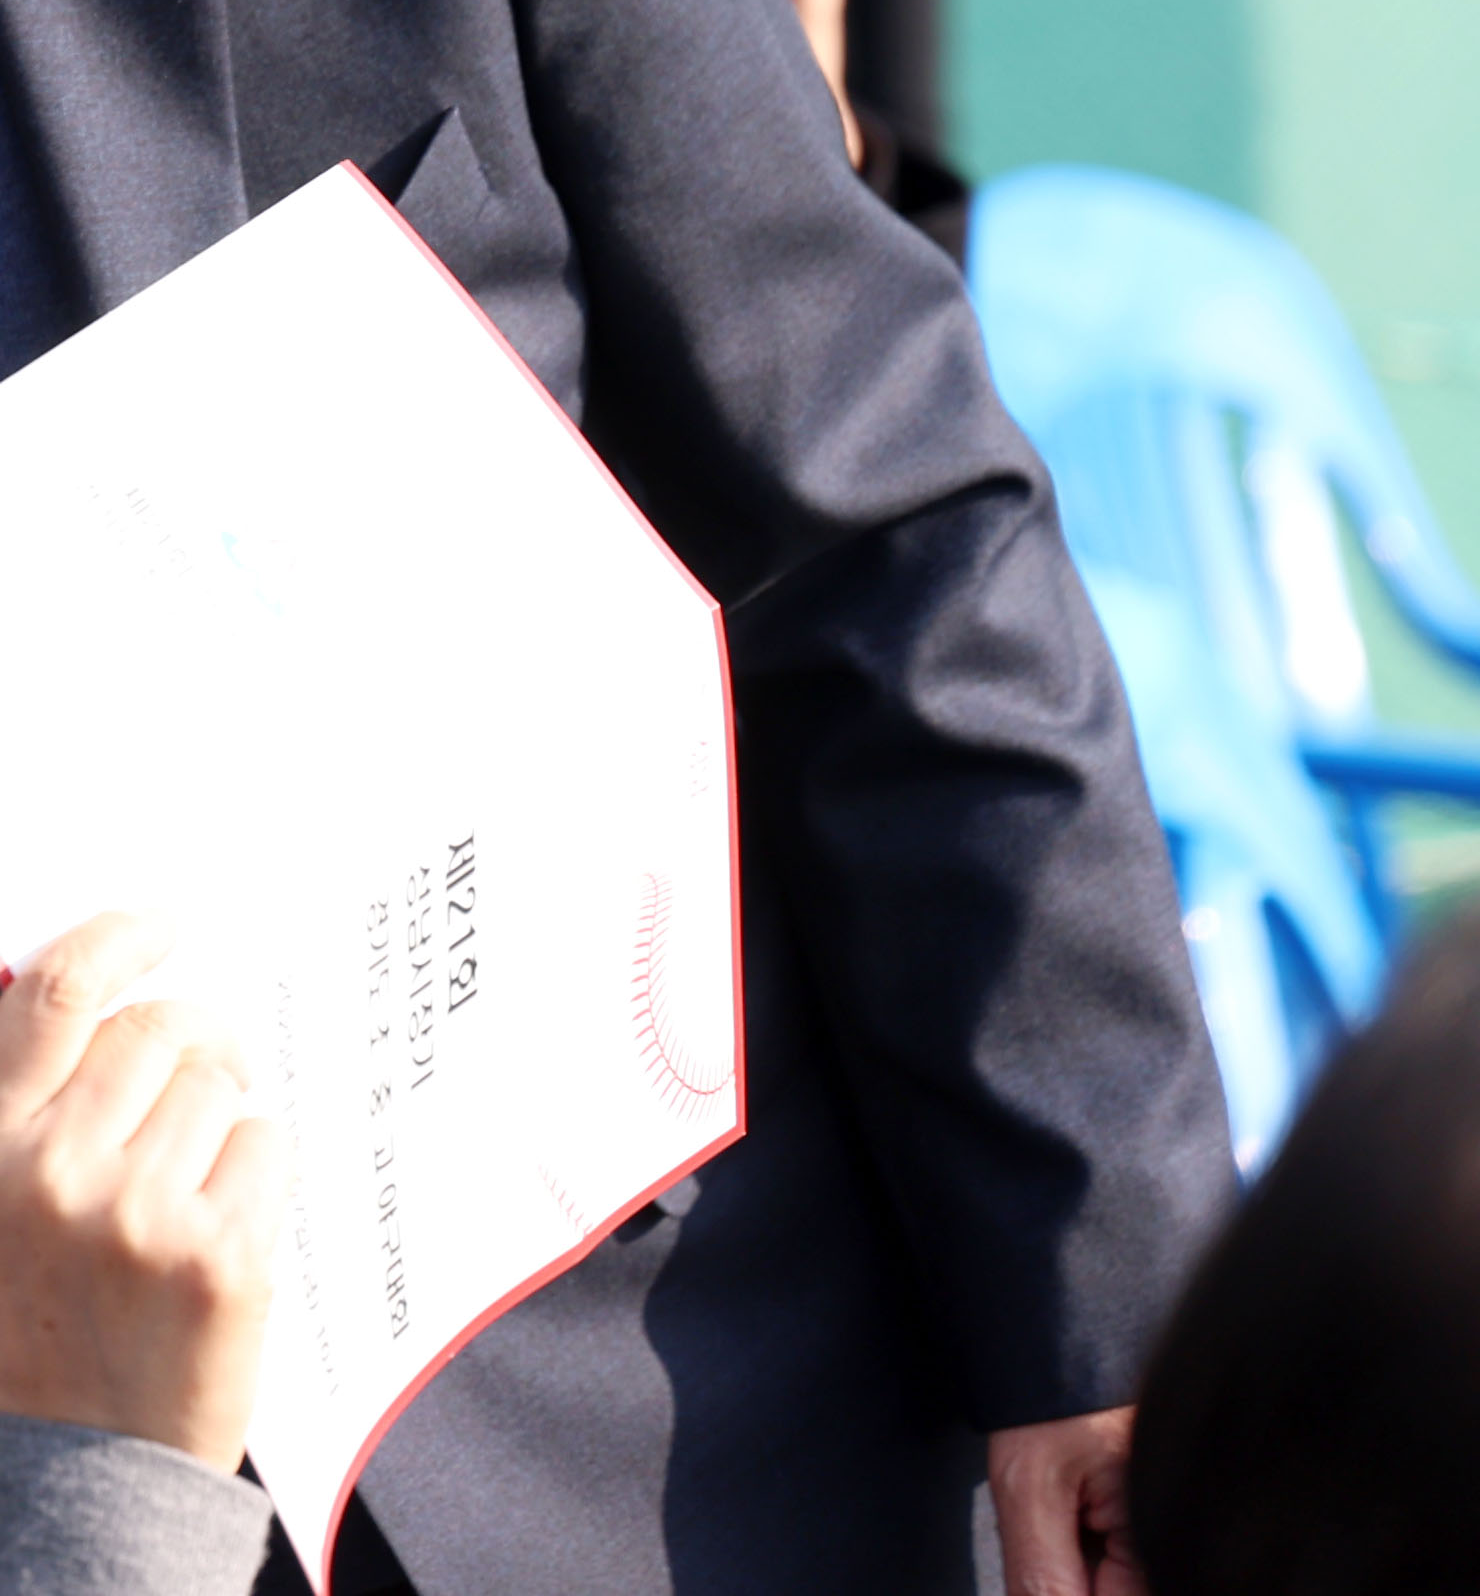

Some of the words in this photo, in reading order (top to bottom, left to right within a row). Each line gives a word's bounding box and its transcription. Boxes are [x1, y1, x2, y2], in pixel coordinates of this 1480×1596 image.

[367, 894, 390, 1004] 경기도
[406, 865, 434, 1091] 성남시장기
[446, 828, 478, 1014] 제21회
[377, 1183, 410, 1340] 야구대회
